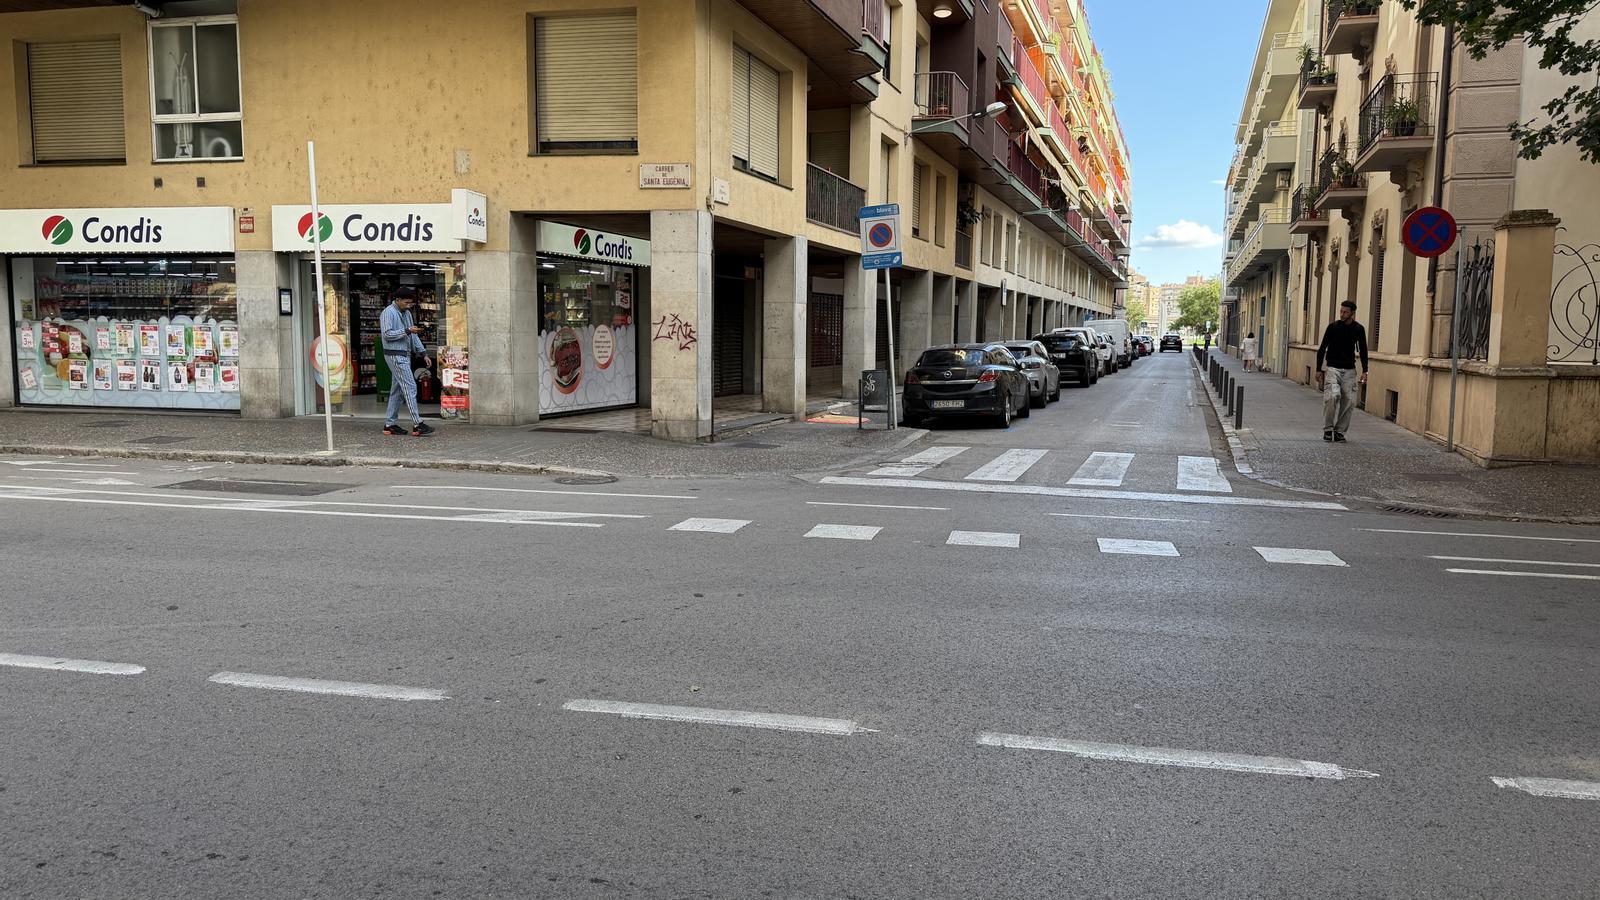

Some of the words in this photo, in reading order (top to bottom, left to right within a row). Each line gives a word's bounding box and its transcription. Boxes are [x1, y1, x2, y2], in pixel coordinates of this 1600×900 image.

[655, 165, 675, 173] CARRER
[643, 177, 661, 186] SANTA
[82, 216, 162, 244] Condis
[343, 214, 433, 242] Condis
[468, 215, 485, 227] Condis
[595, 234, 633, 261] Condis
